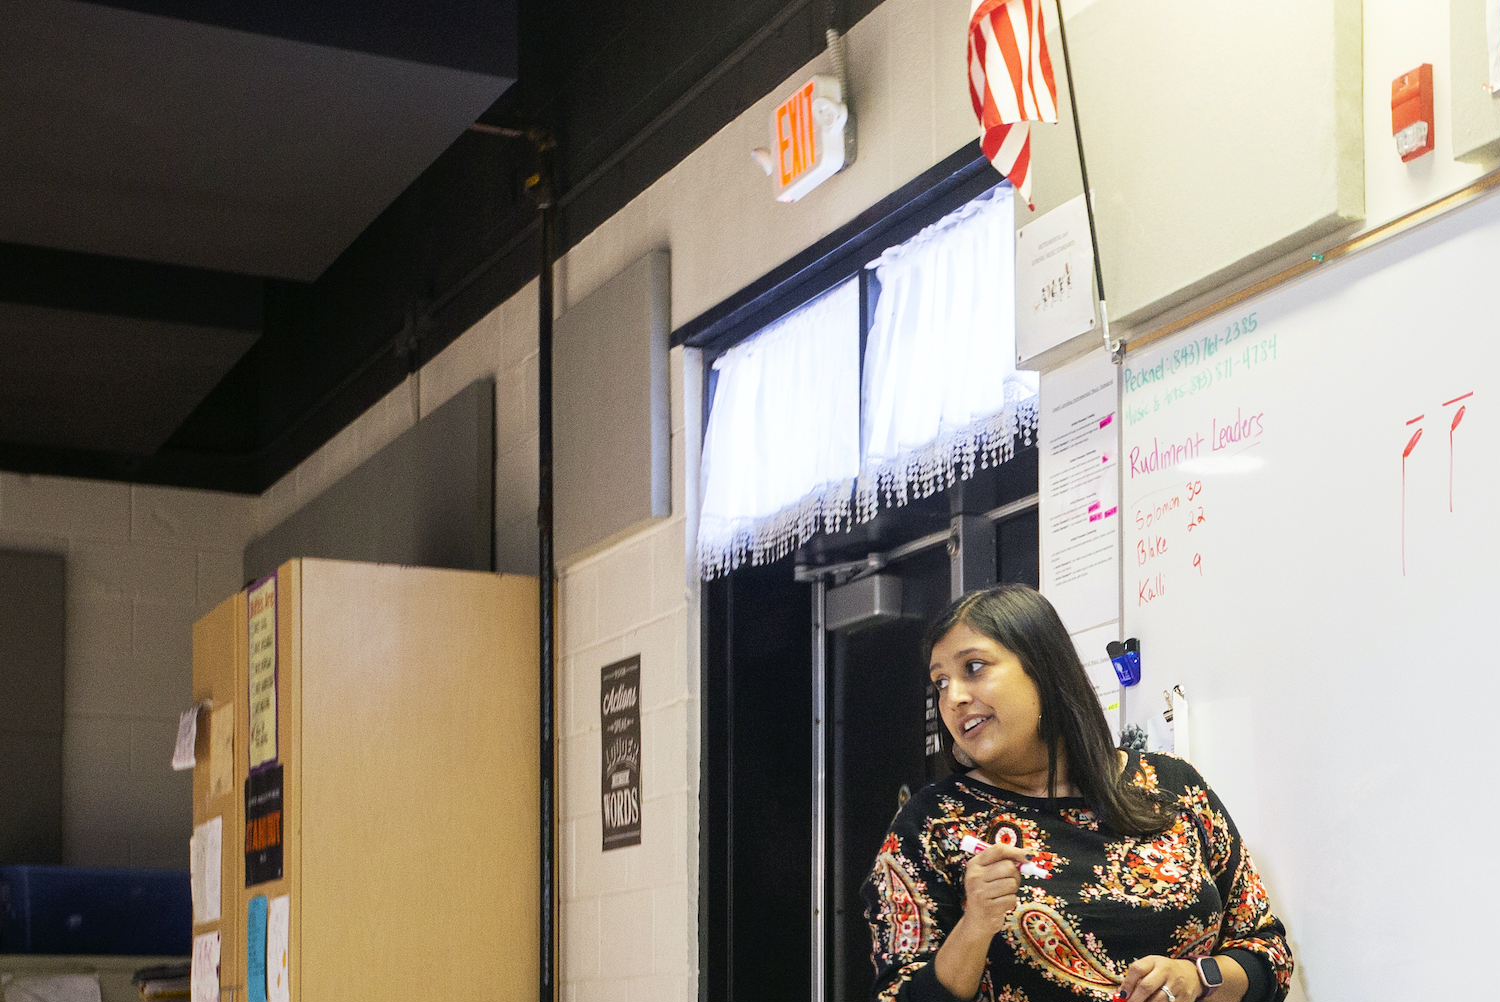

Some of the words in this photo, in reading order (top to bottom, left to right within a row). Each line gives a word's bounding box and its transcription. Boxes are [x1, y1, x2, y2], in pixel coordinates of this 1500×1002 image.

[774, 79, 817, 190] EXIT
[1129, 432, 1205, 479] Rudiment
[1212, 407, 1264, 451] Leaders
[1136, 495, 1180, 531] Solomon
[1186, 480, 1203, 501] 30
[1137, 535, 1168, 567] Blake
[1187, 506, 1207, 532] 22
[1138, 572, 1166, 607] Kalli
[603, 683, 637, 716] Actions
[604, 786, 640, 829] WORDS
